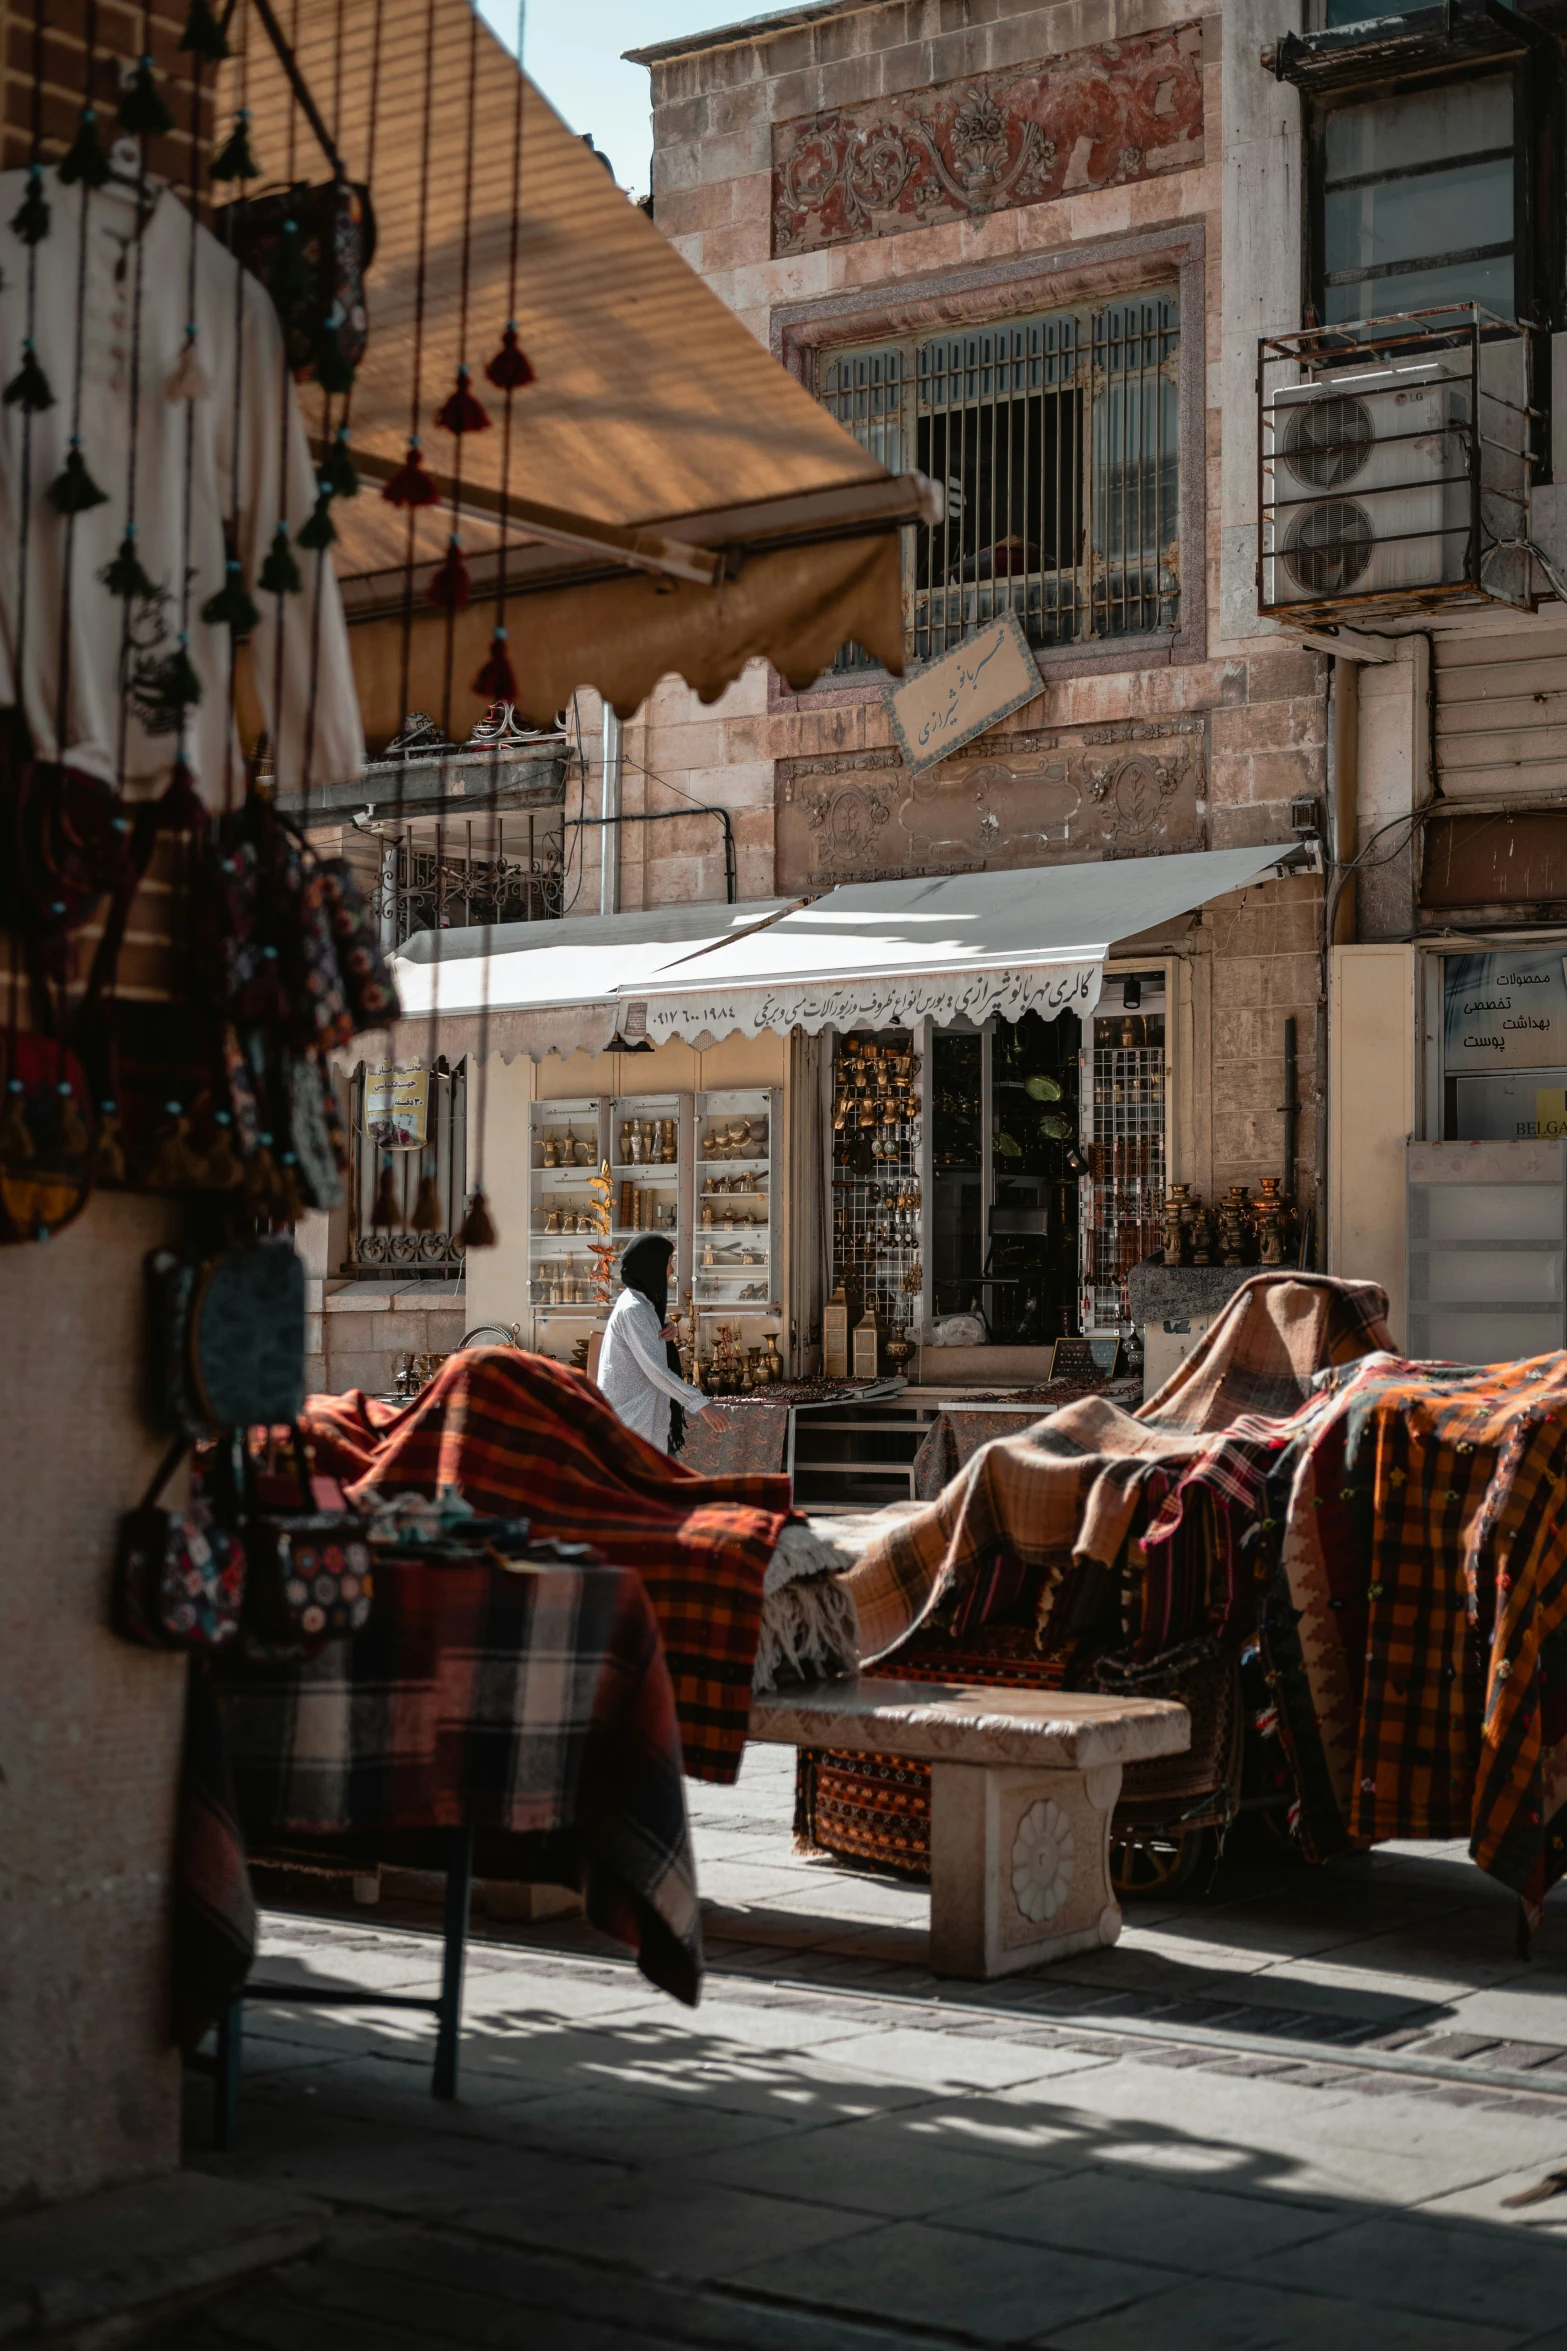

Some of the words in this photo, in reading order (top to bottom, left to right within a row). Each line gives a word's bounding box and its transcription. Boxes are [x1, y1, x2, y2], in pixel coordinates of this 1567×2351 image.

[1410, 392, 1423, 402] LG
[956, 628, 1005, 690] مهربانو
[918, 688, 959, 746] شیرازی
[1048, 967, 1095, 1008] گالری
[1496, 973, 1551, 987] محصولات
[754, 993, 781, 1027] برنجی
[784, 997, 807, 1025] مسی
[859, 989, 896, 1019] ظروف
[893, 987, 922, 1016] انواع
[916, 991, 946, 1014] بورس
[1463, 997, 1511, 1014] تخصصی
[1502, 1015, 1550, 1030] بهداشت
[1463, 1035, 1505, 1052] پوست
